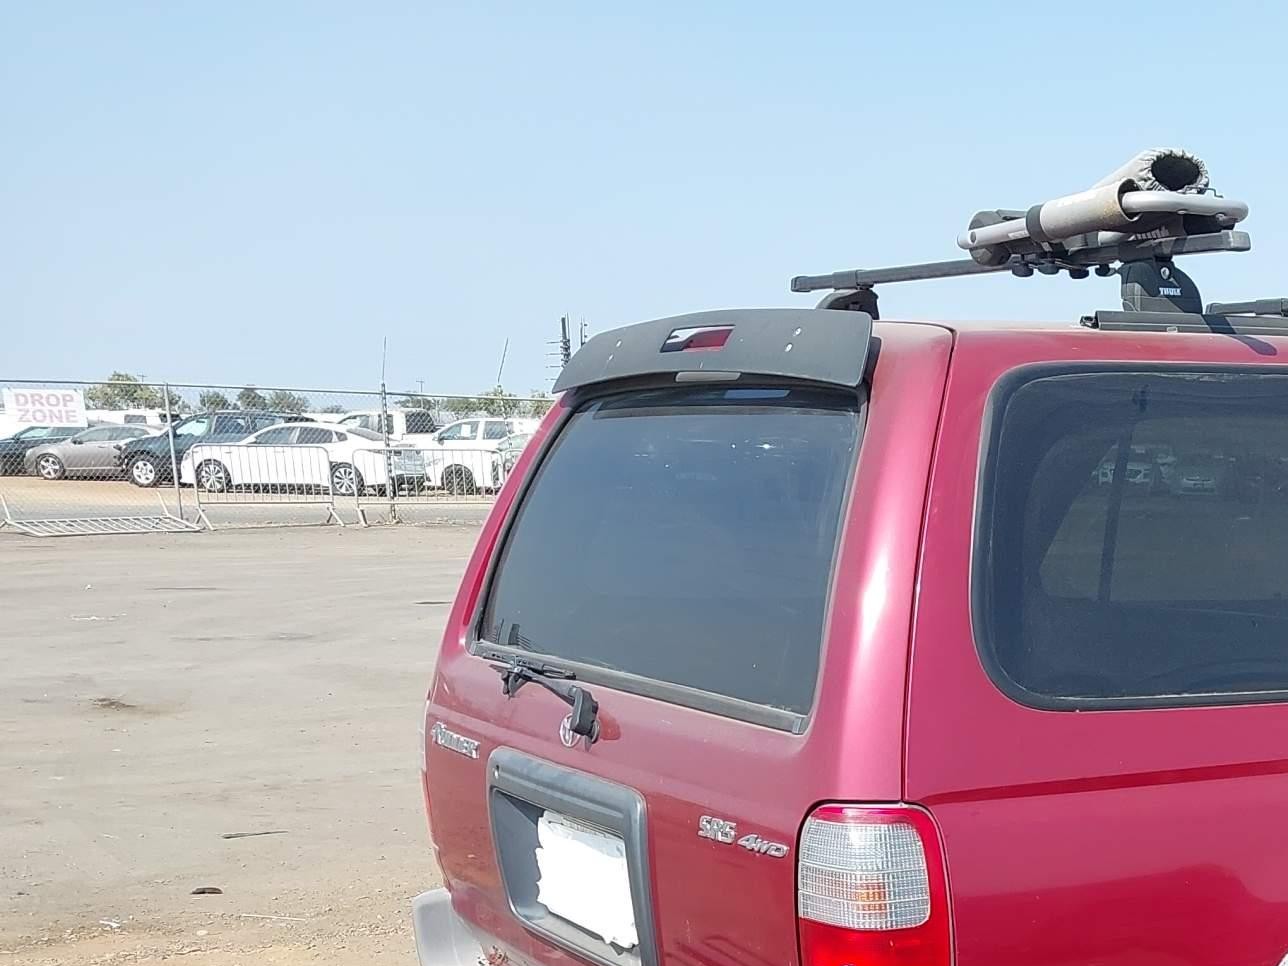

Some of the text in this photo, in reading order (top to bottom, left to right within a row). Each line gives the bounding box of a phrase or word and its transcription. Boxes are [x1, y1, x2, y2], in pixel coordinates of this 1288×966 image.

[14, 393, 74, 407] DROP
[17, 408, 78, 423] ZONE
[737, 834, 790, 857] 4WD
